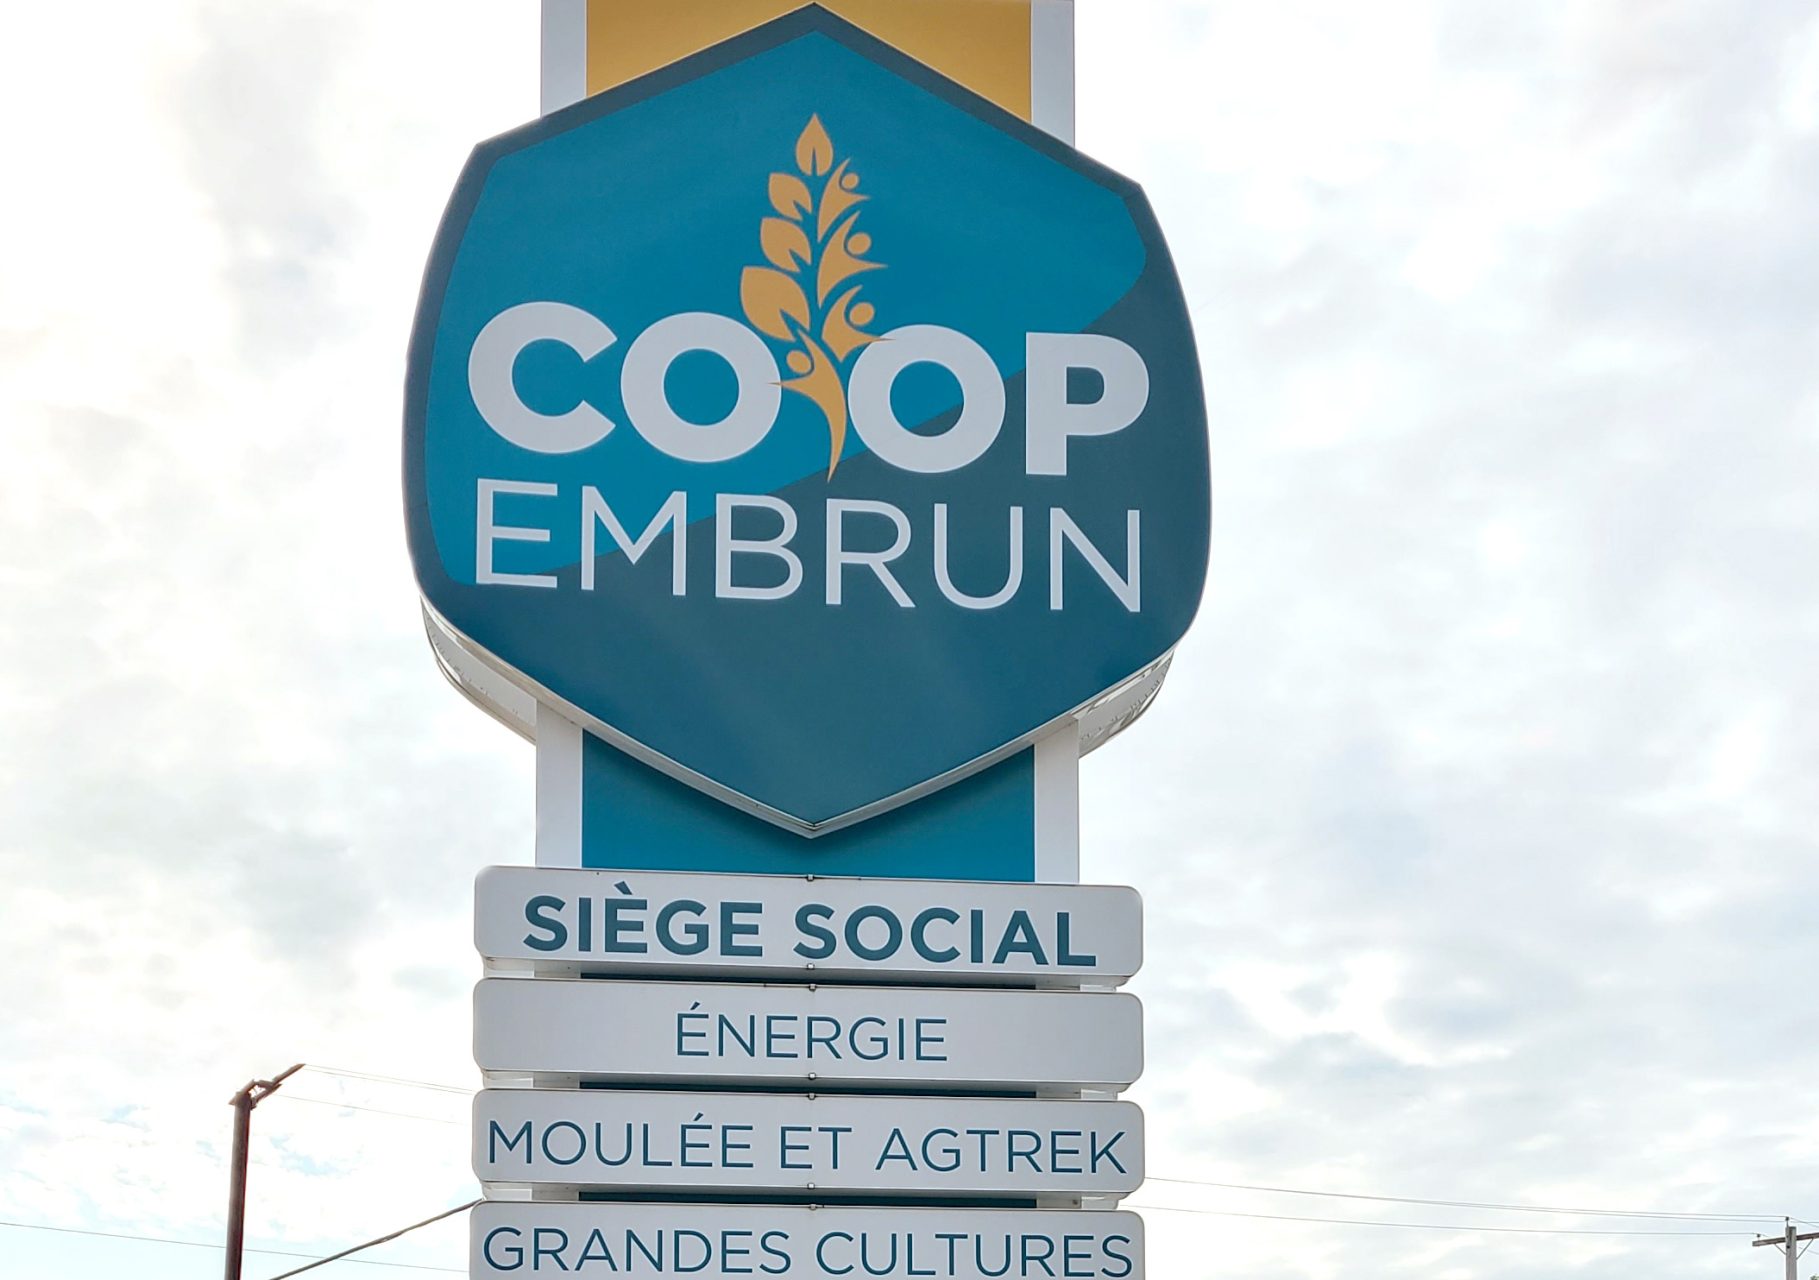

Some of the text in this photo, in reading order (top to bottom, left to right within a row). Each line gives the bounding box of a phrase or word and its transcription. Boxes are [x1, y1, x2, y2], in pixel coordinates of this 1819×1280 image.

[476, 478, 1141, 613] EMBRUN
[523, 881, 1097, 967] SIÈGE SOCIAL
[676, 1002, 948, 1062] ÉNERGIE
[488, 1113, 1128, 1175] MOULÉE ET AGTREK
[483, 1227, 1133, 1279] GRANDES CULTURES
